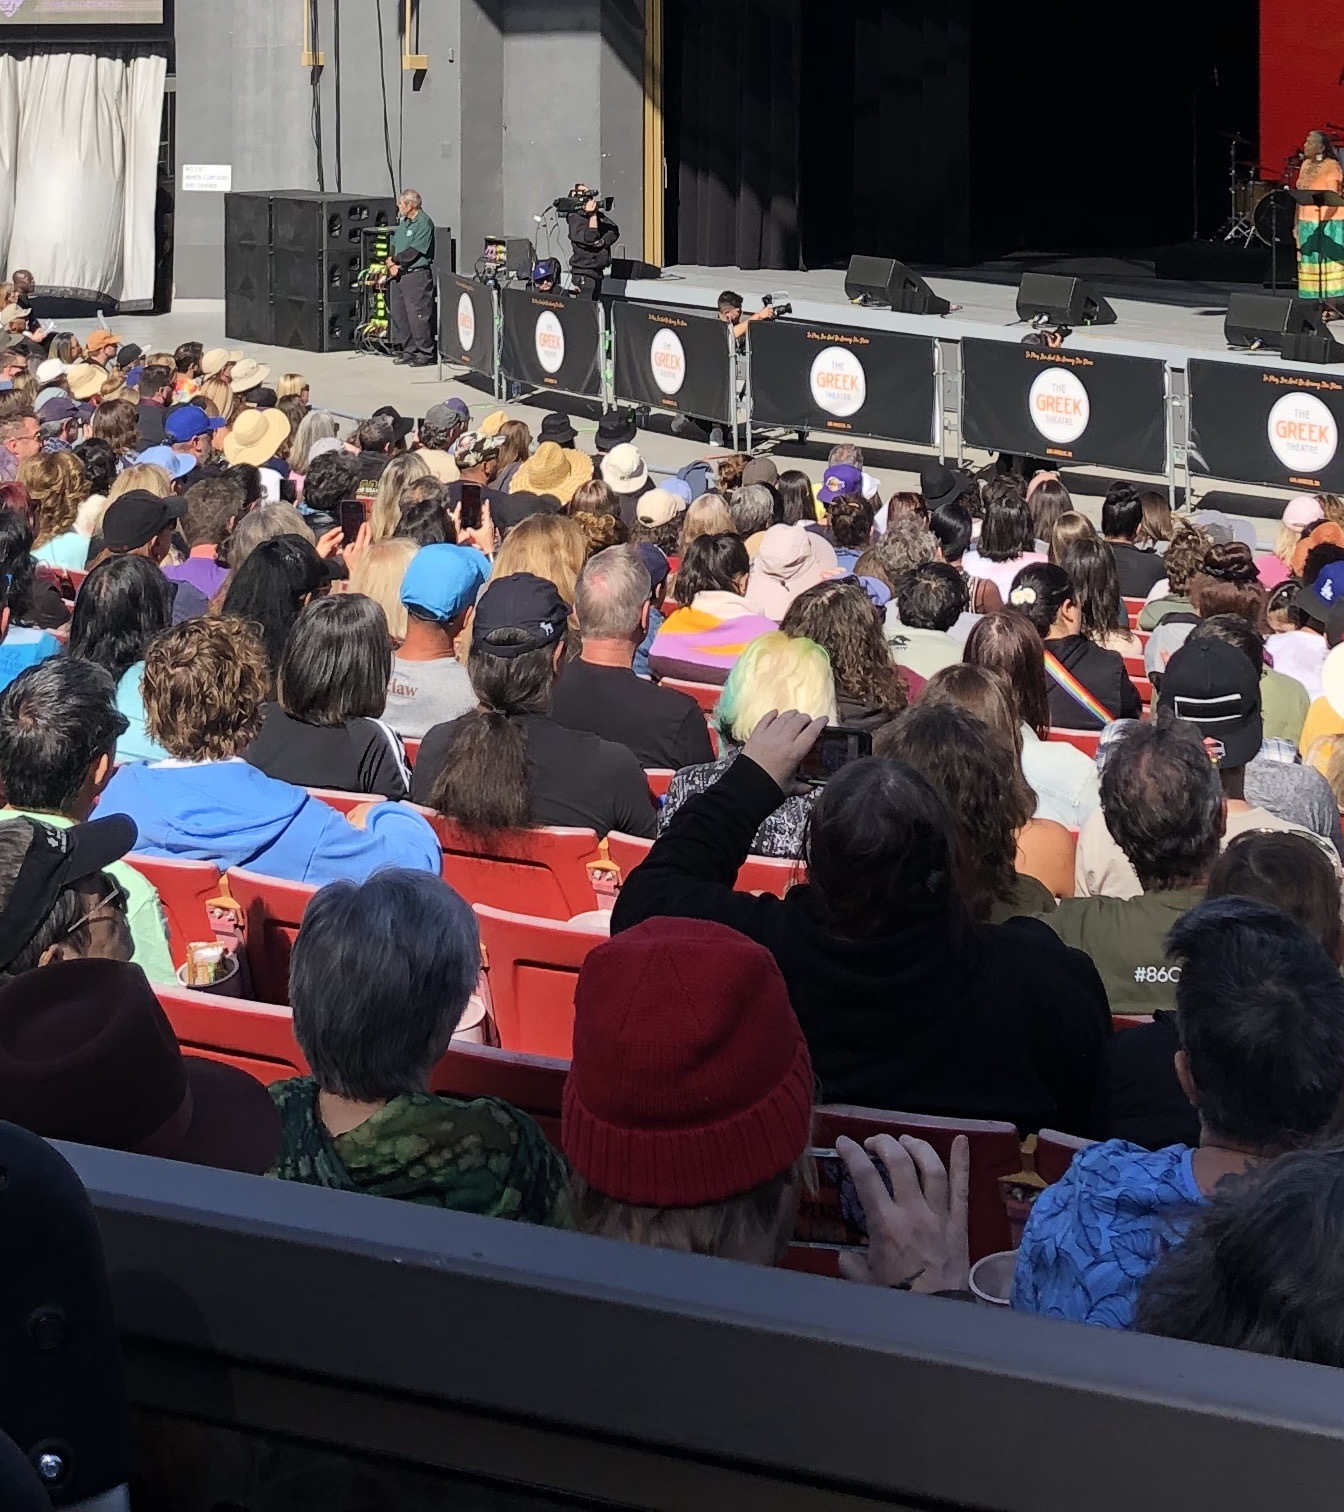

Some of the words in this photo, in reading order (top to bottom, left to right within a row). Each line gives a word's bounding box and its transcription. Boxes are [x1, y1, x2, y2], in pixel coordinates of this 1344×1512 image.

[538, 332, 561, 350] GREEK
[654, 351, 681, 371] GREEK
[832, 361, 844, 371] THE
[816, 371, 860, 392] GREEK
[1051, 382, 1066, 393] THE
[825, 391, 852, 401] THEATRE
[1035, 393, 1082, 416] GREEK
[1045, 414, 1073, 426] THEATRE
[1294, 408, 1311, 420] THE
[1275, 419, 1329, 444] GREEK
[1286, 442, 1319, 454] THEATRE
